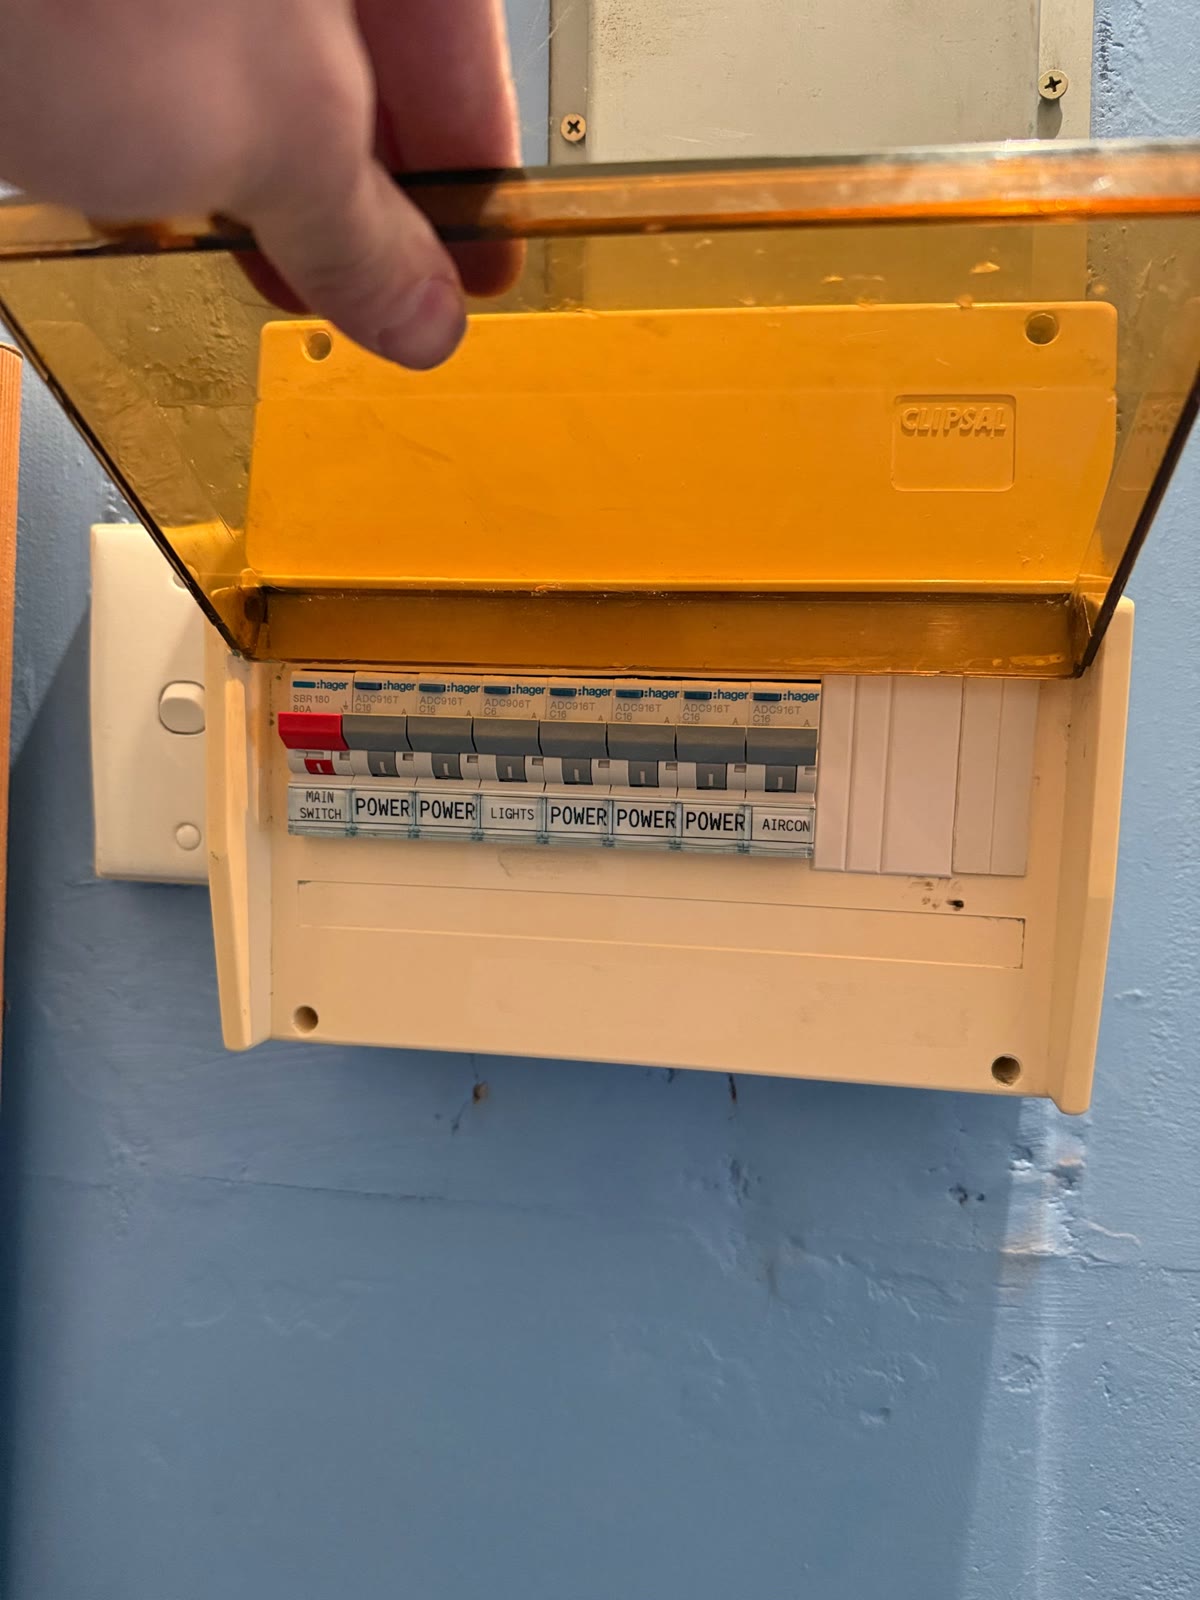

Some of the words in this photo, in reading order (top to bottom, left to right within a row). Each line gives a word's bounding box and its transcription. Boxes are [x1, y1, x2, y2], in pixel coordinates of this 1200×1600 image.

[900, 406, 1007, 437] CLIPSAL
[305, 790, 335, 804] MAIN
[355, 797, 411, 818] POWER
[299, 807, 342, 820] SWITCH
[420, 800, 476, 821] POWER
[490, 807, 535, 821] LIGHTS
[550, 806, 608, 827] POWER
[616, 808, 677, 830] POWER
[685, 811, 746, 832] POWER
[762, 818, 811, 833] AIRCON
